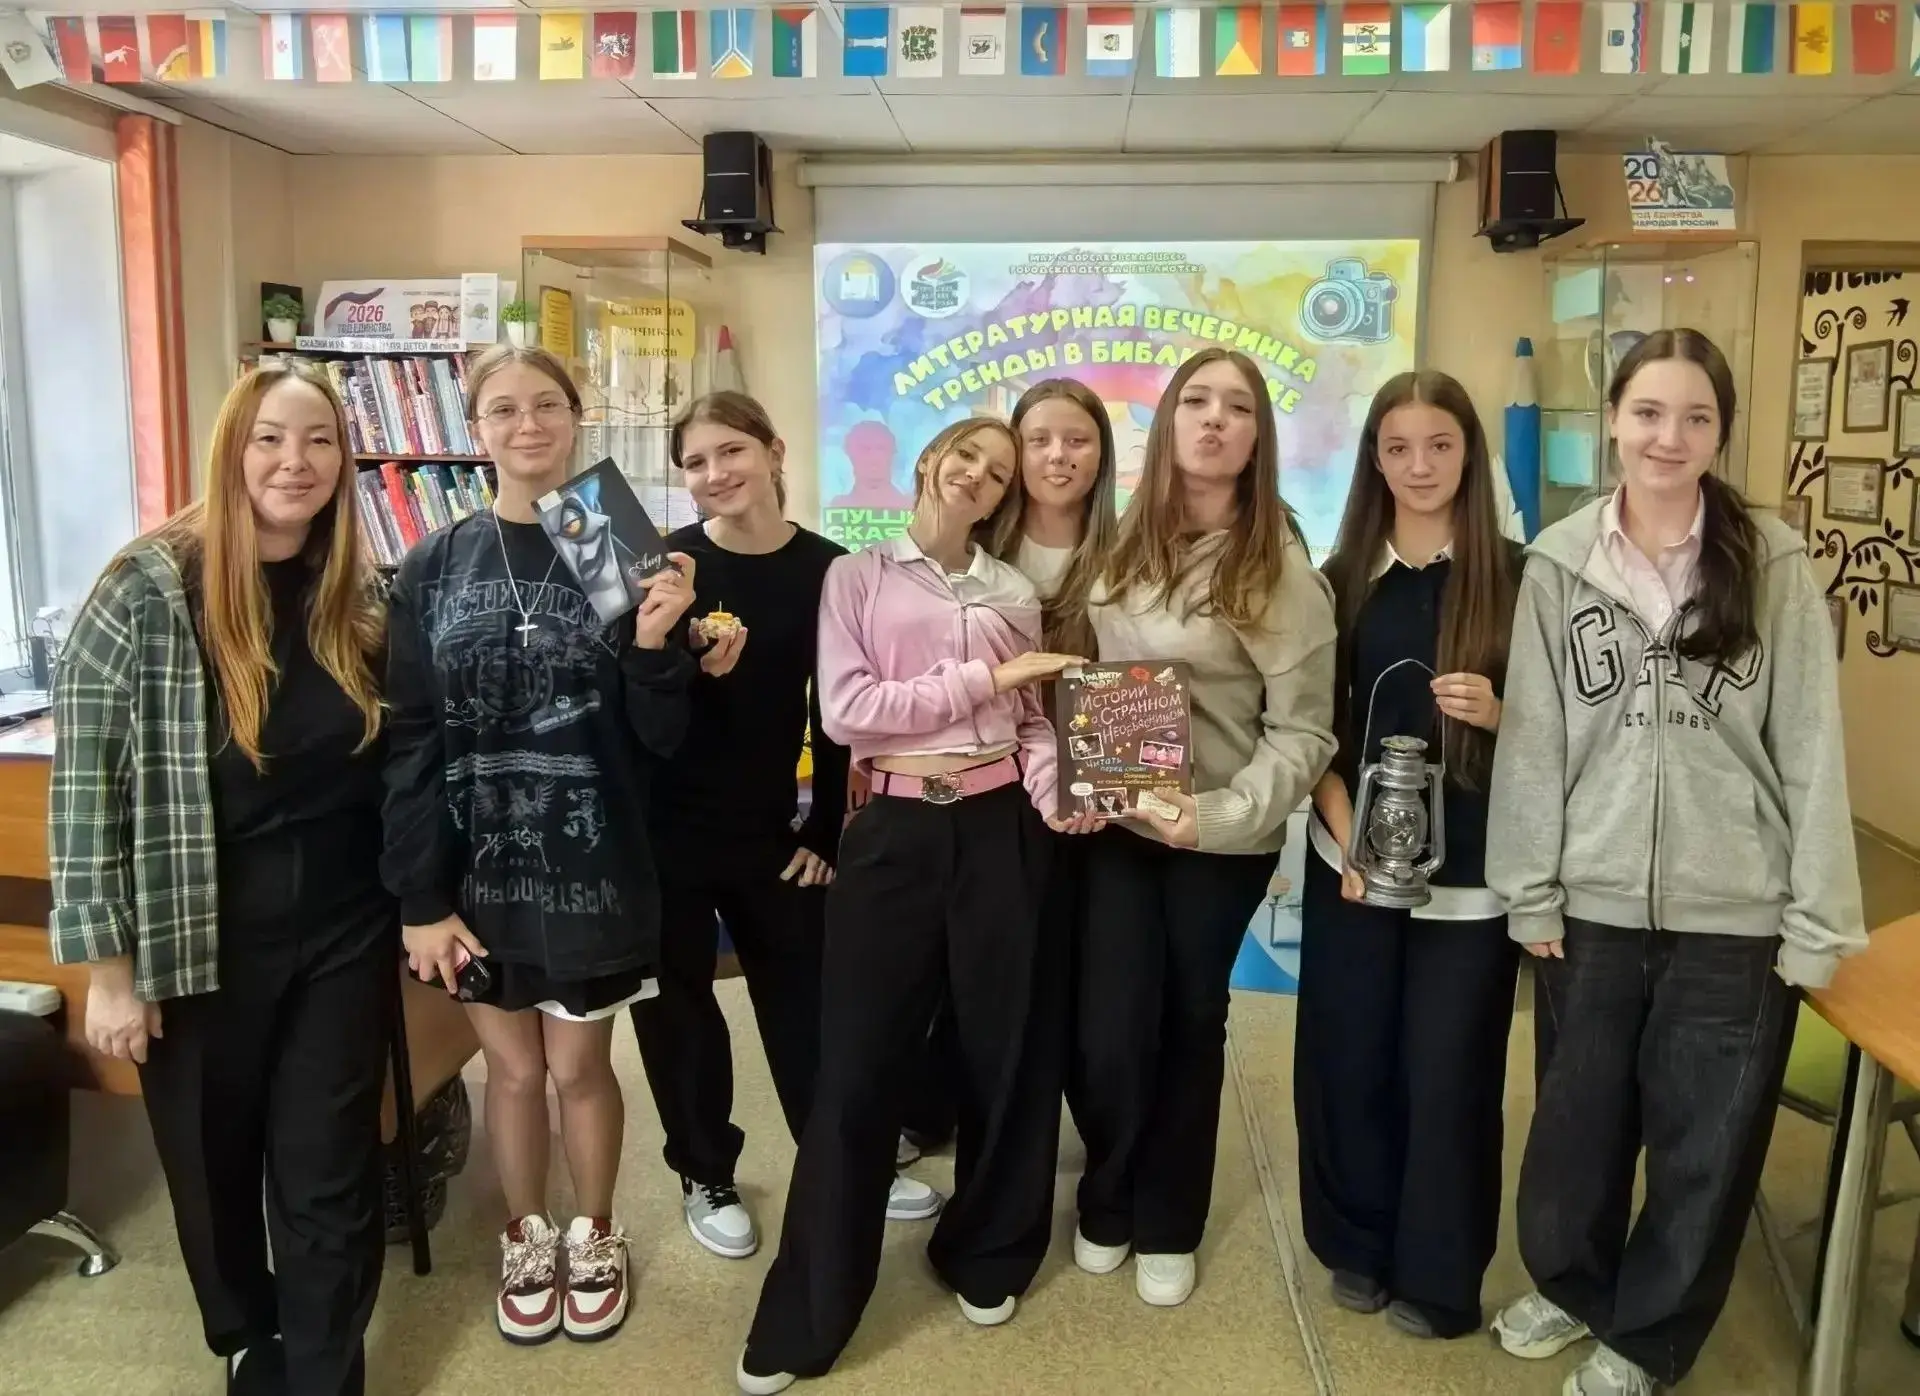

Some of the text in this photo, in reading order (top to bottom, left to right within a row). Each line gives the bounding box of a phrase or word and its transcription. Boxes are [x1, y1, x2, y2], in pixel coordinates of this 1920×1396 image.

[1624, 158, 1660, 179] 20
[1628, 180, 1661, 202] 26
[1653, 211, 1704, 219] ЕДИНСТВА
[1680, 219, 1719, 227] РОССИИ
[348, 305, 384, 322] 2026
[353, 322, 392, 333] ЕДИНСТВА
[300, 339, 327, 348] СКАЗКИ
[403, 342, 428, 351] ДЕТЕЙ
[893, 305, 1318, 396] ЛИТЕРАТУРНАЯ ВЕЧЕРИНКА
[923, 340, 1302, 414] ТРЕНДЫ В БИБЛИКЕ
[1080, 684, 1148, 712] ИСТОРИИ
